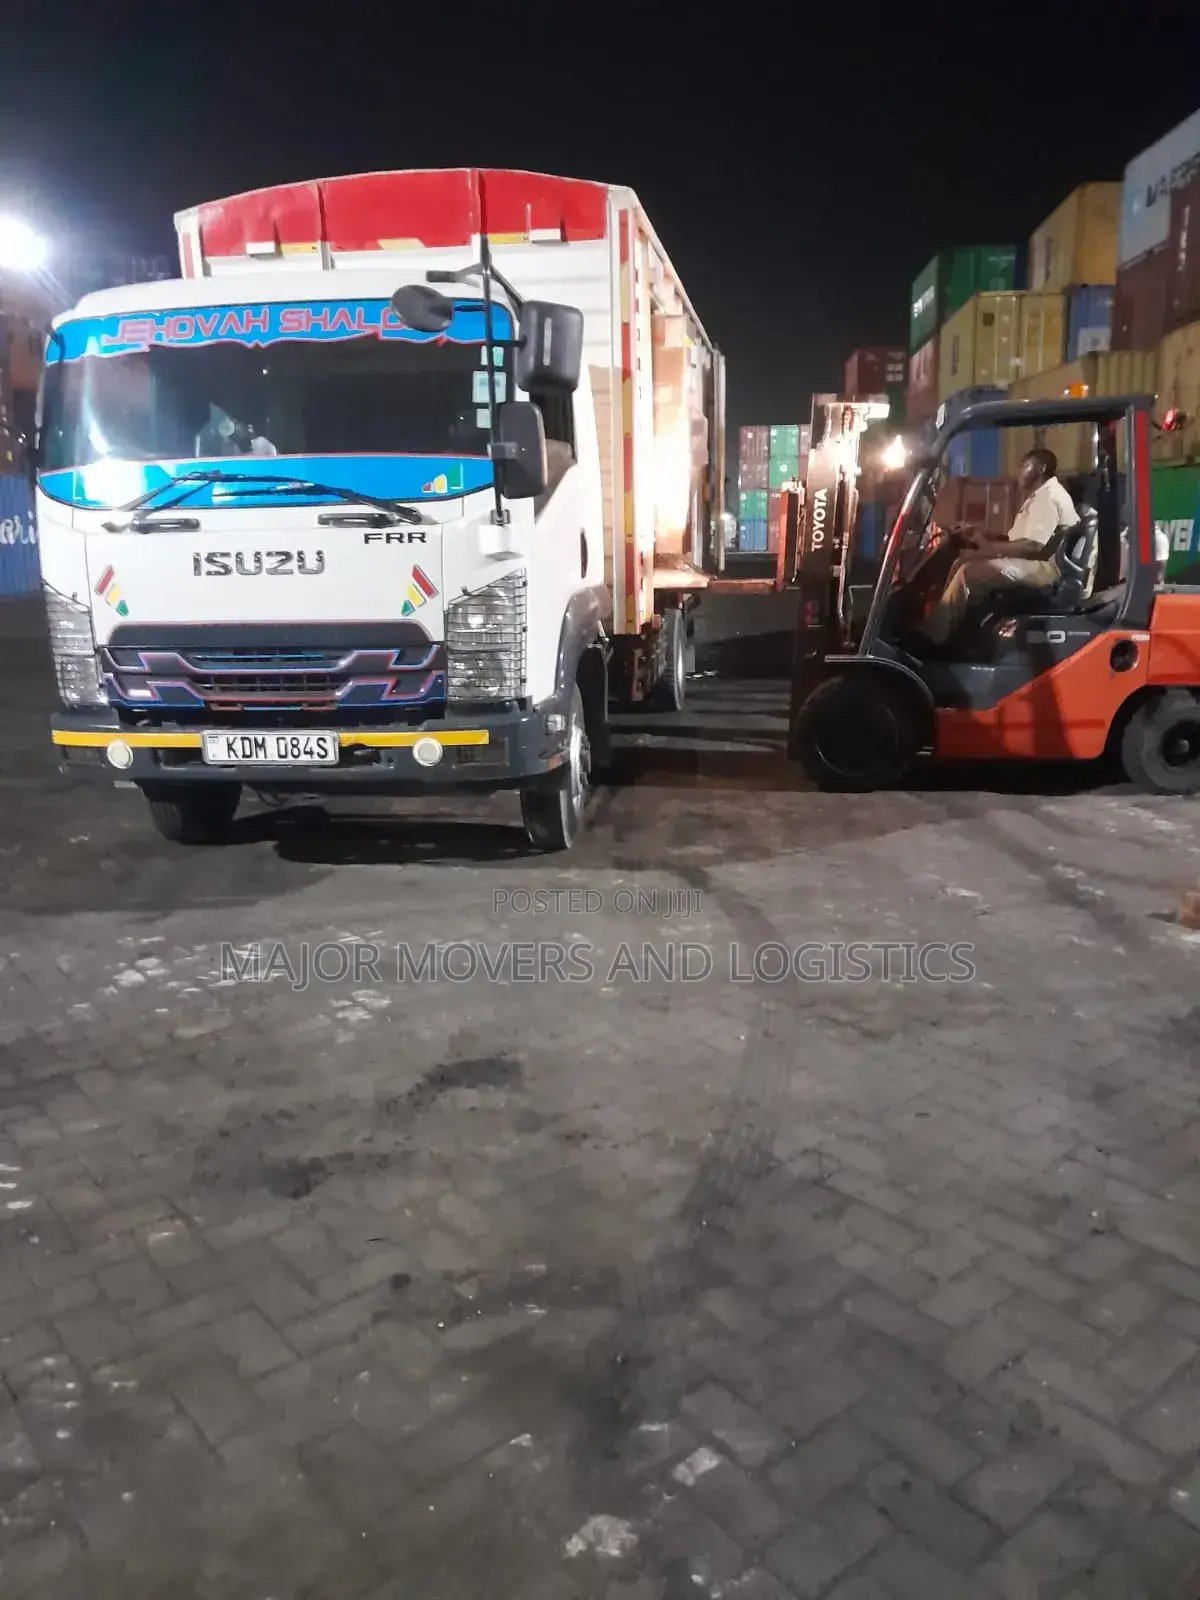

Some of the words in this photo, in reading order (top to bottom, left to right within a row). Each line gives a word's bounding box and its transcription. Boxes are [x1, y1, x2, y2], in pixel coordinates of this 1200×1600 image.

[101, 306, 269, 346] JEHOVAH
[279, 306, 412, 332] SHALO
[811, 487, 828, 552] TOYOTA
[363, 531, 428, 545] FRR
[193, 550, 326, 577] ISUZU
[225, 736, 268, 759] KDM
[275, 736, 329, 760] 084S
